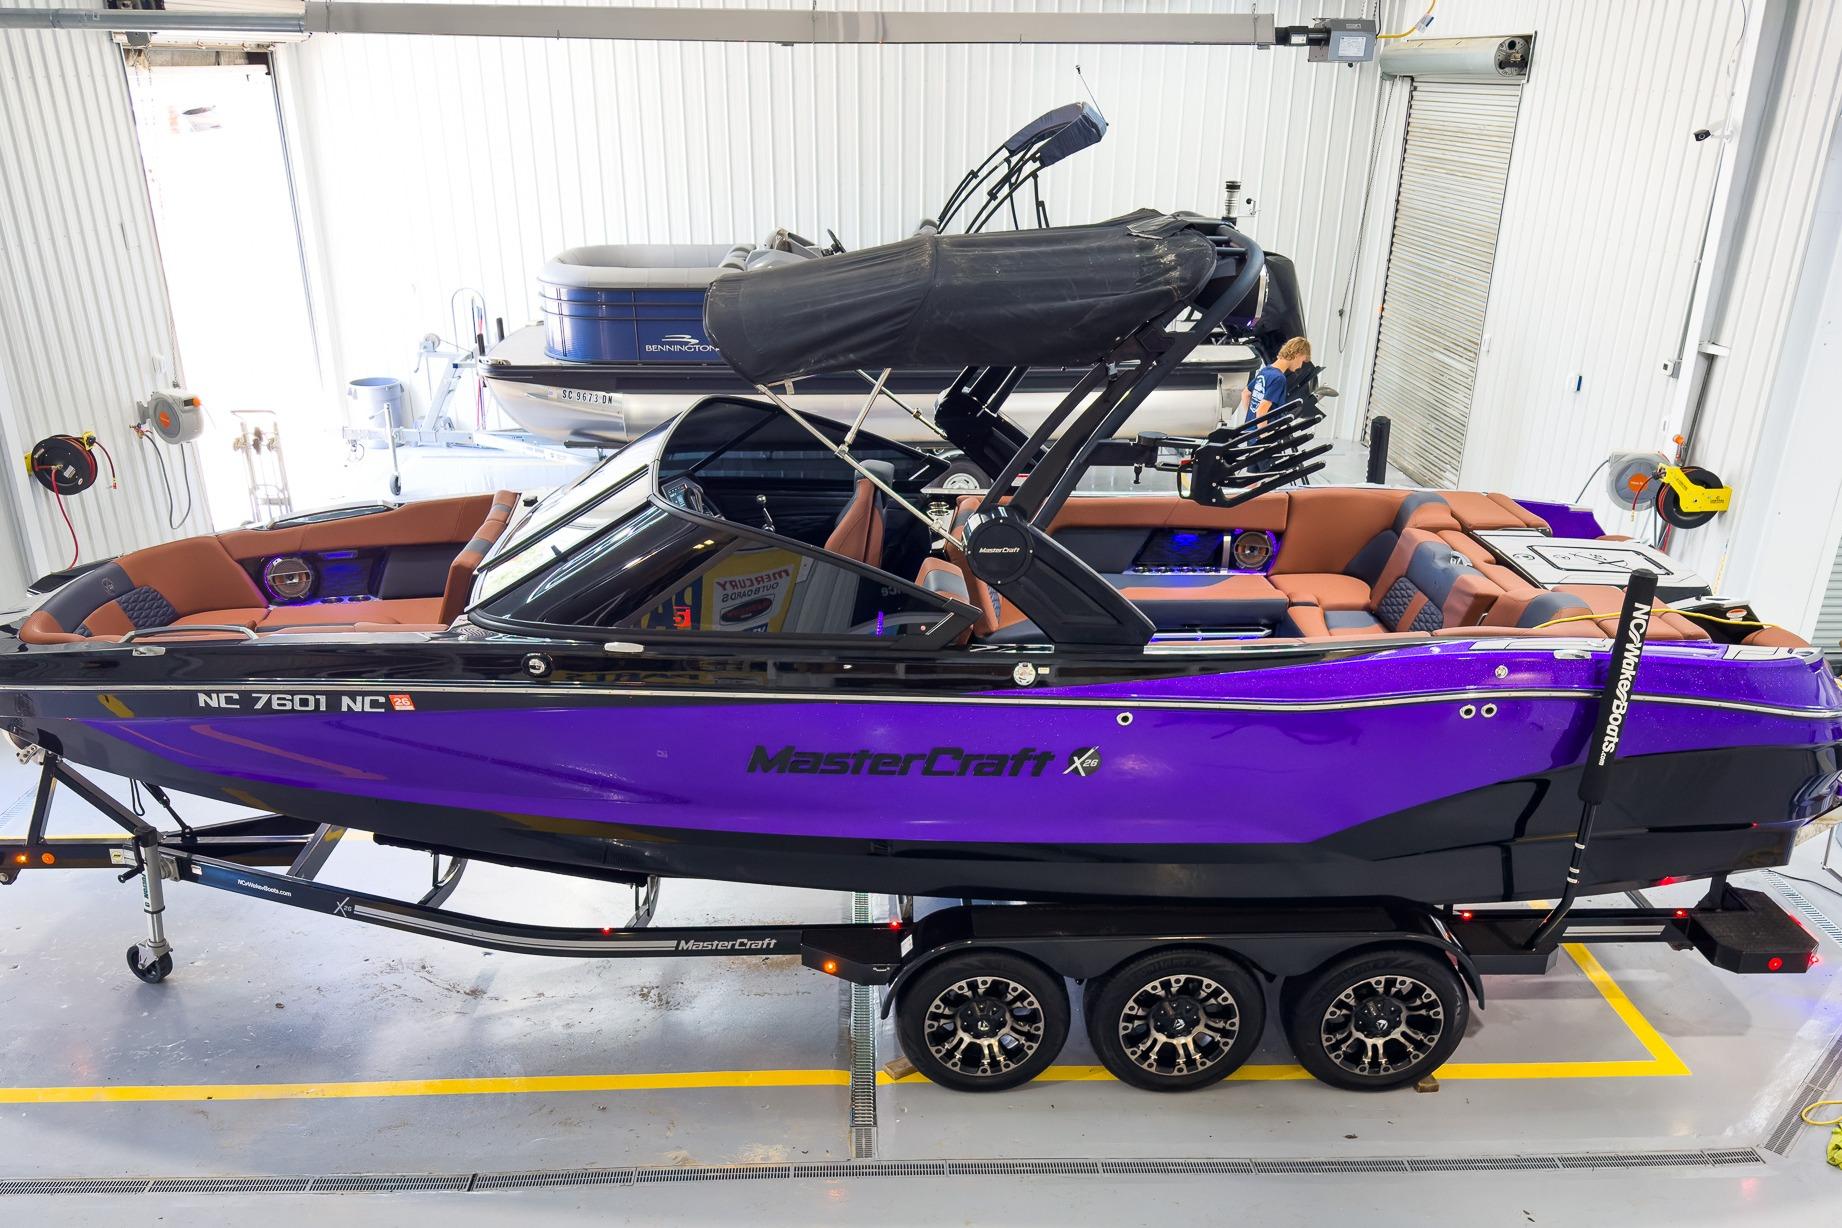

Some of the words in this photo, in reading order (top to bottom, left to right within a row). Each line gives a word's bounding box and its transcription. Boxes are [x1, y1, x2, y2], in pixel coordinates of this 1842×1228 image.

[645, 344, 719, 352] BENNINGTON
[562, 389, 573, 400] SC
[576, 391, 599, 403] 9673
[602, 394, 613, 405] DN
[197, 692, 240, 709] NC
[251, 693, 327, 711] 7601
[341, 695, 386, 713] NC
[393, 697, 411, 706] 26
[746, 746, 1055, 777] MasterCraft
[678, 938, 778, 951] MasterCraft
